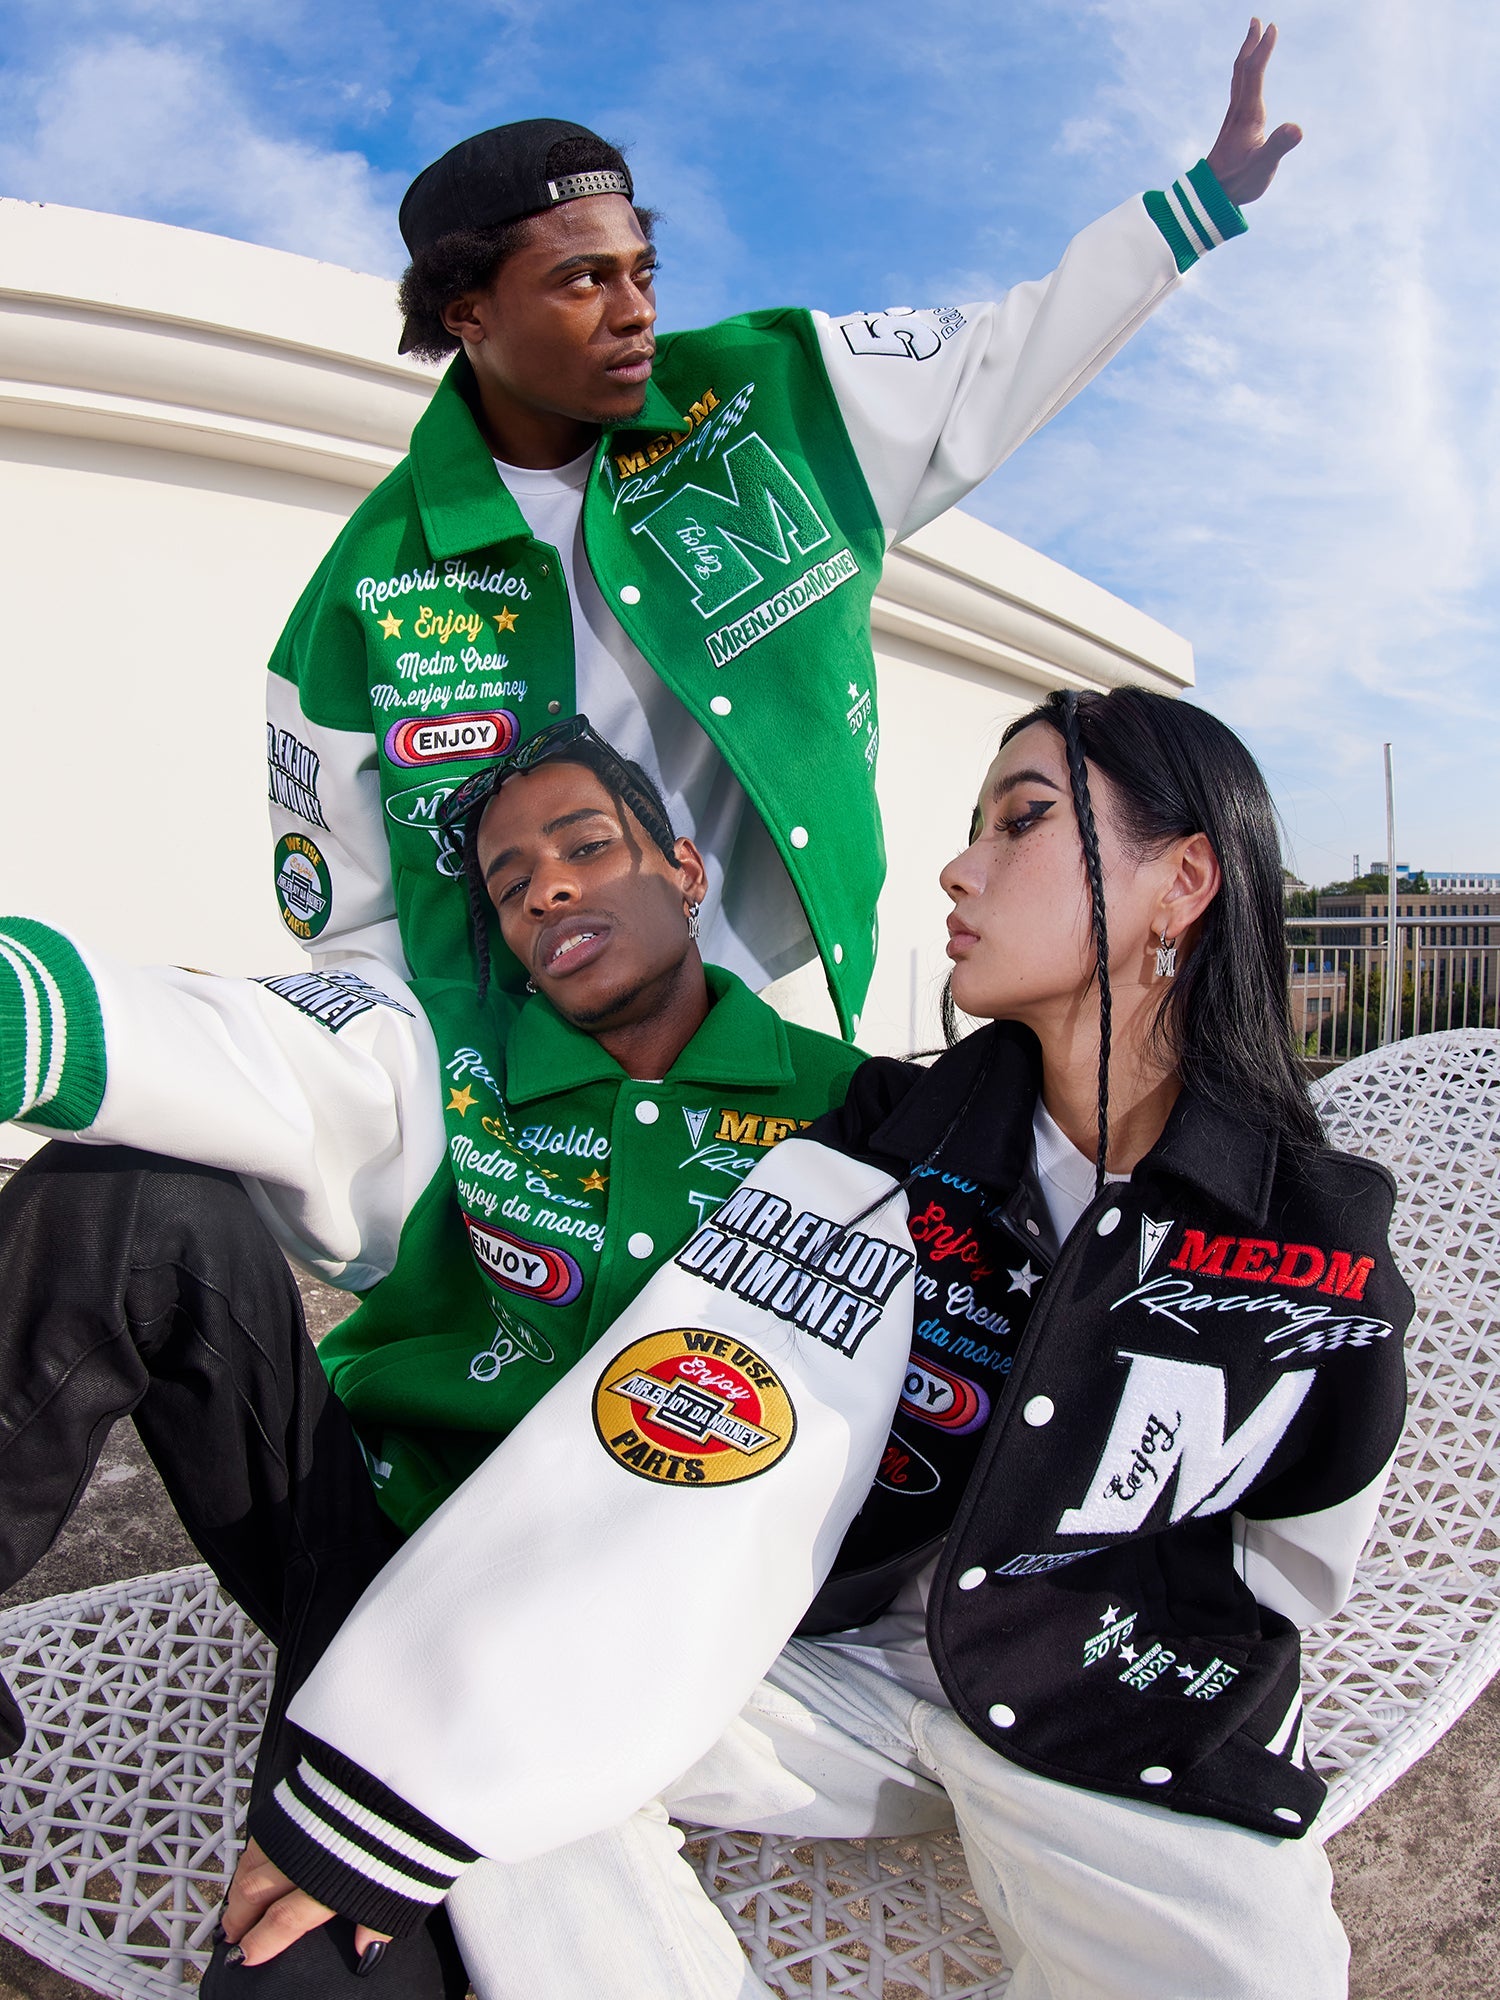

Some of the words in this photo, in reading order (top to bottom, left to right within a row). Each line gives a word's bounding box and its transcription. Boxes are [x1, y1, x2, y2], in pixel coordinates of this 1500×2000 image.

[631, 432, 831, 619] M
[356, 562, 440, 614] Record
[444, 560, 532, 601] Holder
[414, 605, 483, 644] Enjoy
[396, 651, 458, 683] Medm
[461, 646, 509, 674] Crew
[370, 682, 453, 712] Mr.enjoy
[454, 679, 478, 700] da
[480, 679, 528, 702] money
[418, 726, 492, 751] ENJOY
[284, 836, 302, 852] WE
[302, 839, 322, 867] USE
[283, 906, 312, 938] PARTS
[518, 1124, 612, 1160] Holde
[715, 1108, 814, 1148] ME
[451, 1134, 518, 1182] Medm
[458, 1178, 498, 1217] enjoy
[501, 1195, 532, 1222] da
[471, 1230, 541, 1281] ENJOY
[710, 1187, 916, 1307] MR.ENJOY
[1168, 1228, 1376, 1302] MEDM
[674, 1227, 749, 1291] DA
[731, 1249, 884, 1360] MONEY
[946, 1281, 1011, 1335] Crew
[1110, 1273, 1335, 1343] Racing
[682, 1331, 732, 1358] WE
[730, 1346, 778, 1391] USE
[917, 1318, 950, 1347] da
[948, 1335, 1012, 1375] mone
[679, 1356, 751, 1401] Enjoy
[623, 1377, 694, 1417] MR.ENJOY
[691, 1408, 712, 1426] DA
[710, 1414, 764, 1448] MONEY
[610, 1428, 706, 1483] PARTS
[1103, 1410, 1182, 1501] Enjoy
[1083, 1622, 1134, 1668] 2019
[1129, 1650, 1177, 1691] 2020
[1195, 1663, 1240, 1701] 2021
